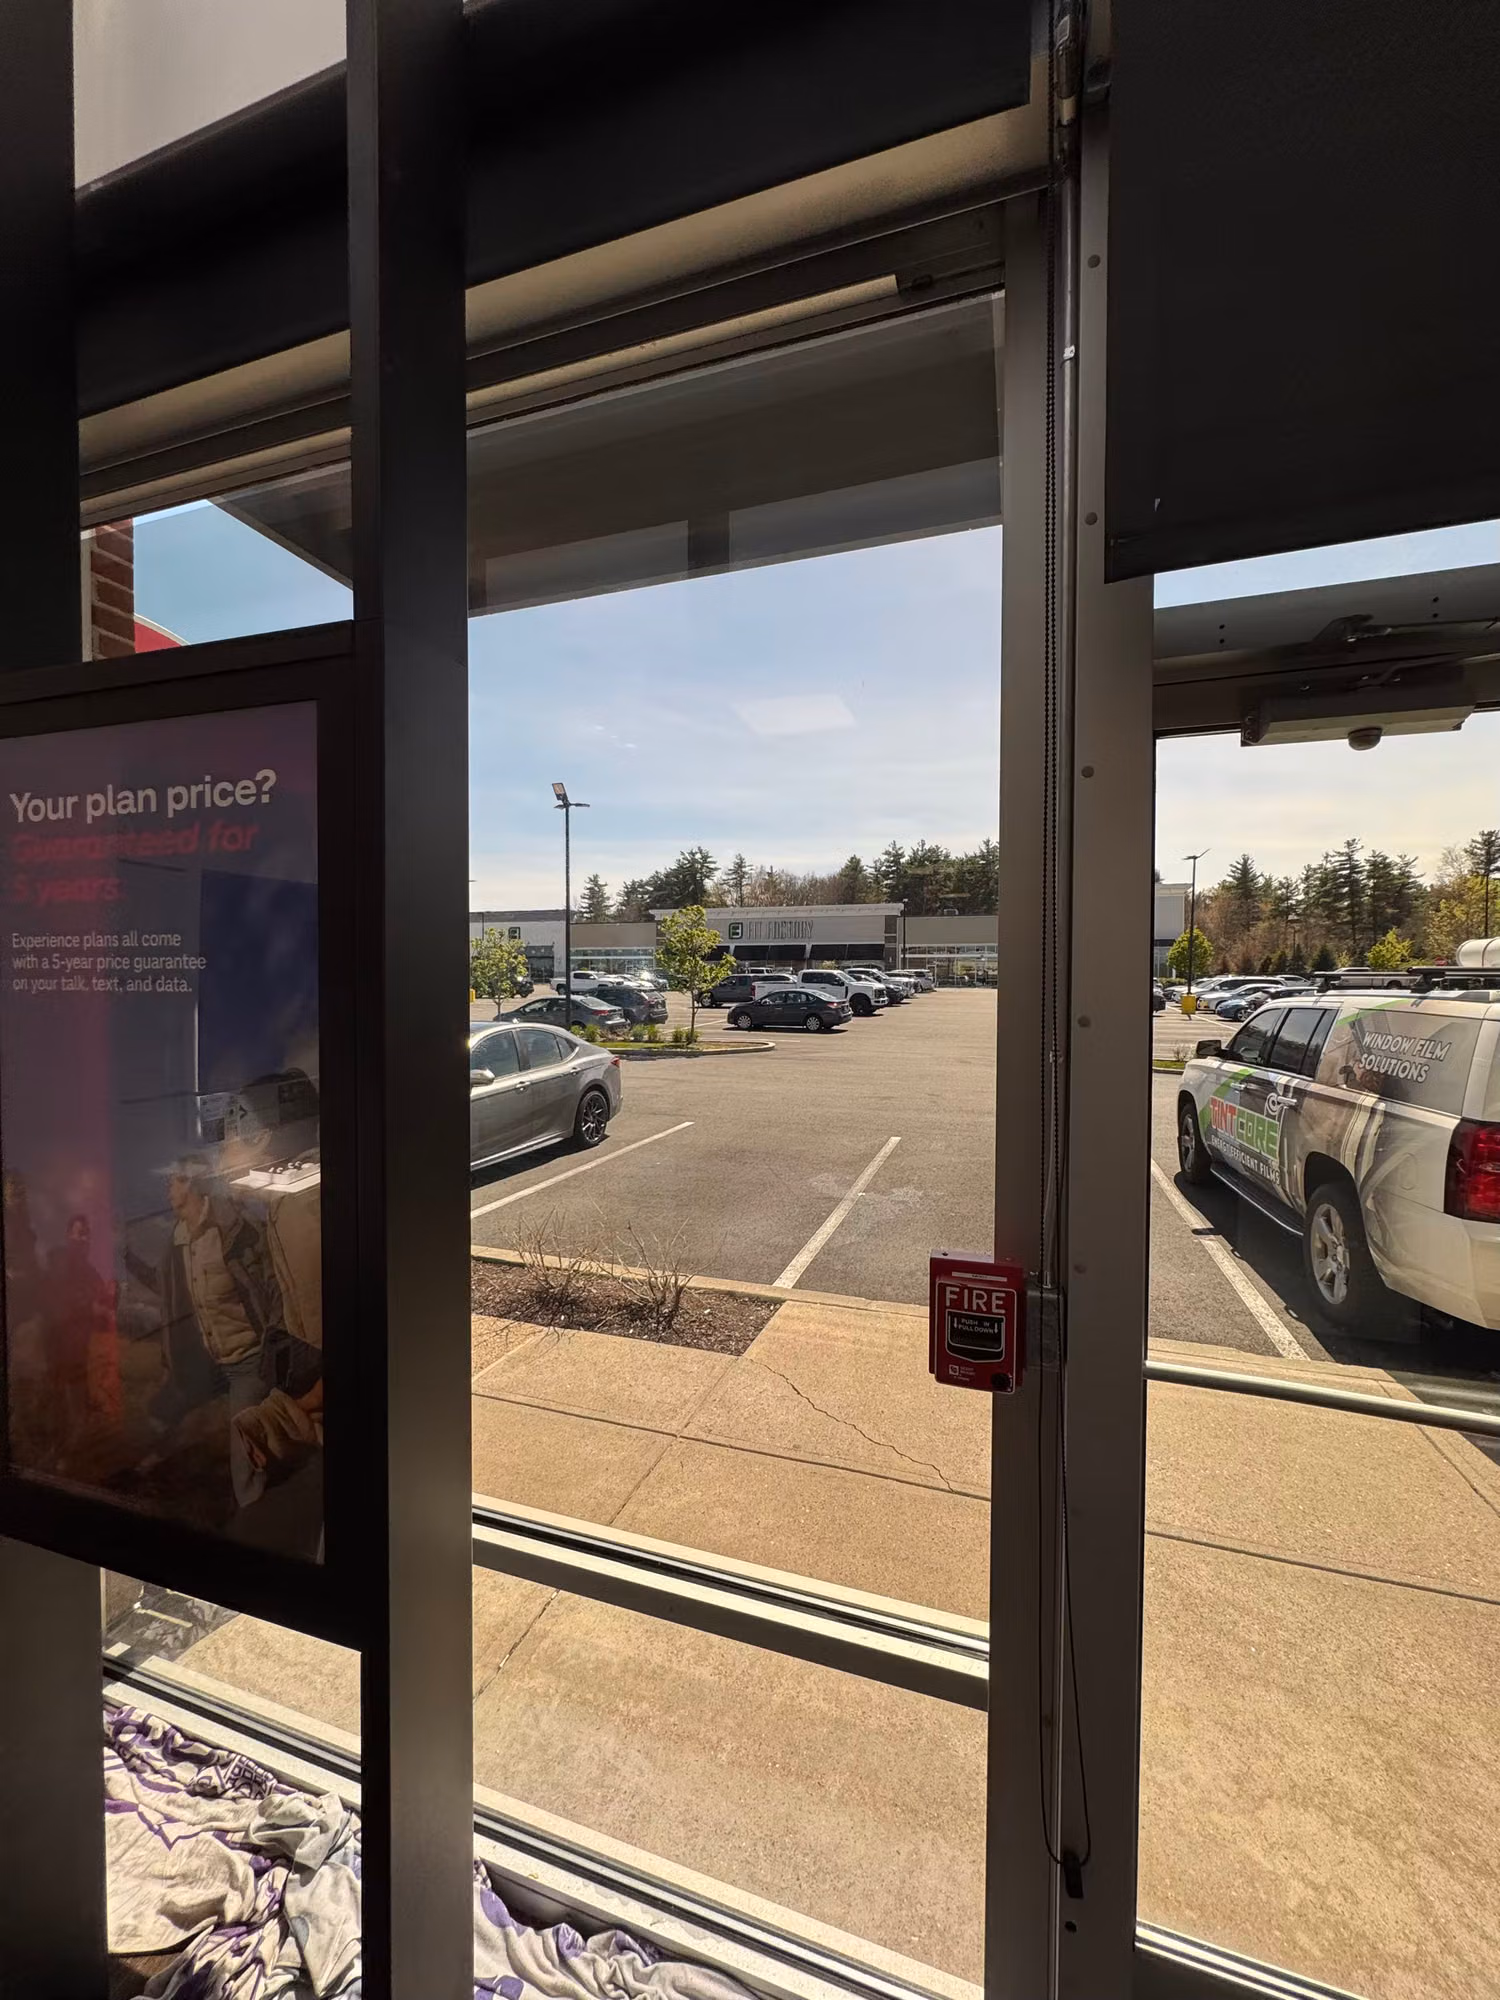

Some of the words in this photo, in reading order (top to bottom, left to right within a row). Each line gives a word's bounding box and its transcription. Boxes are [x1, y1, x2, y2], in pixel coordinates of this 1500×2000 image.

[9, 792, 78, 823] Your
[86, 784, 157, 824] plan
[167, 768, 277, 818] price?
[207, 820, 259, 851] for
[12, 933, 80, 950] Experience
[83, 931, 119, 950] plans
[122, 930, 139, 947] all
[142, 933, 182, 947] come
[12, 954, 39, 970] with
[41, 956, 50, 969] a
[52, 953, 93, 973] 5-year
[97, 954, 130, 973] price
[133, 953, 207, 973] guarantee
[13, 978, 28, 991] on
[31, 978, 57, 994] your
[126, 975, 152, 992] and
[155, 975, 193, 993] data.
[1362, 1031, 1416, 1055] WINDOW
[1412, 1038, 1453, 1062] FILM
[1359, 1052, 1431, 1084] SOLUTIONS
[1259, 1160, 1281, 1186] FILMS
[945, 1286, 1006, 1313] FIRE
